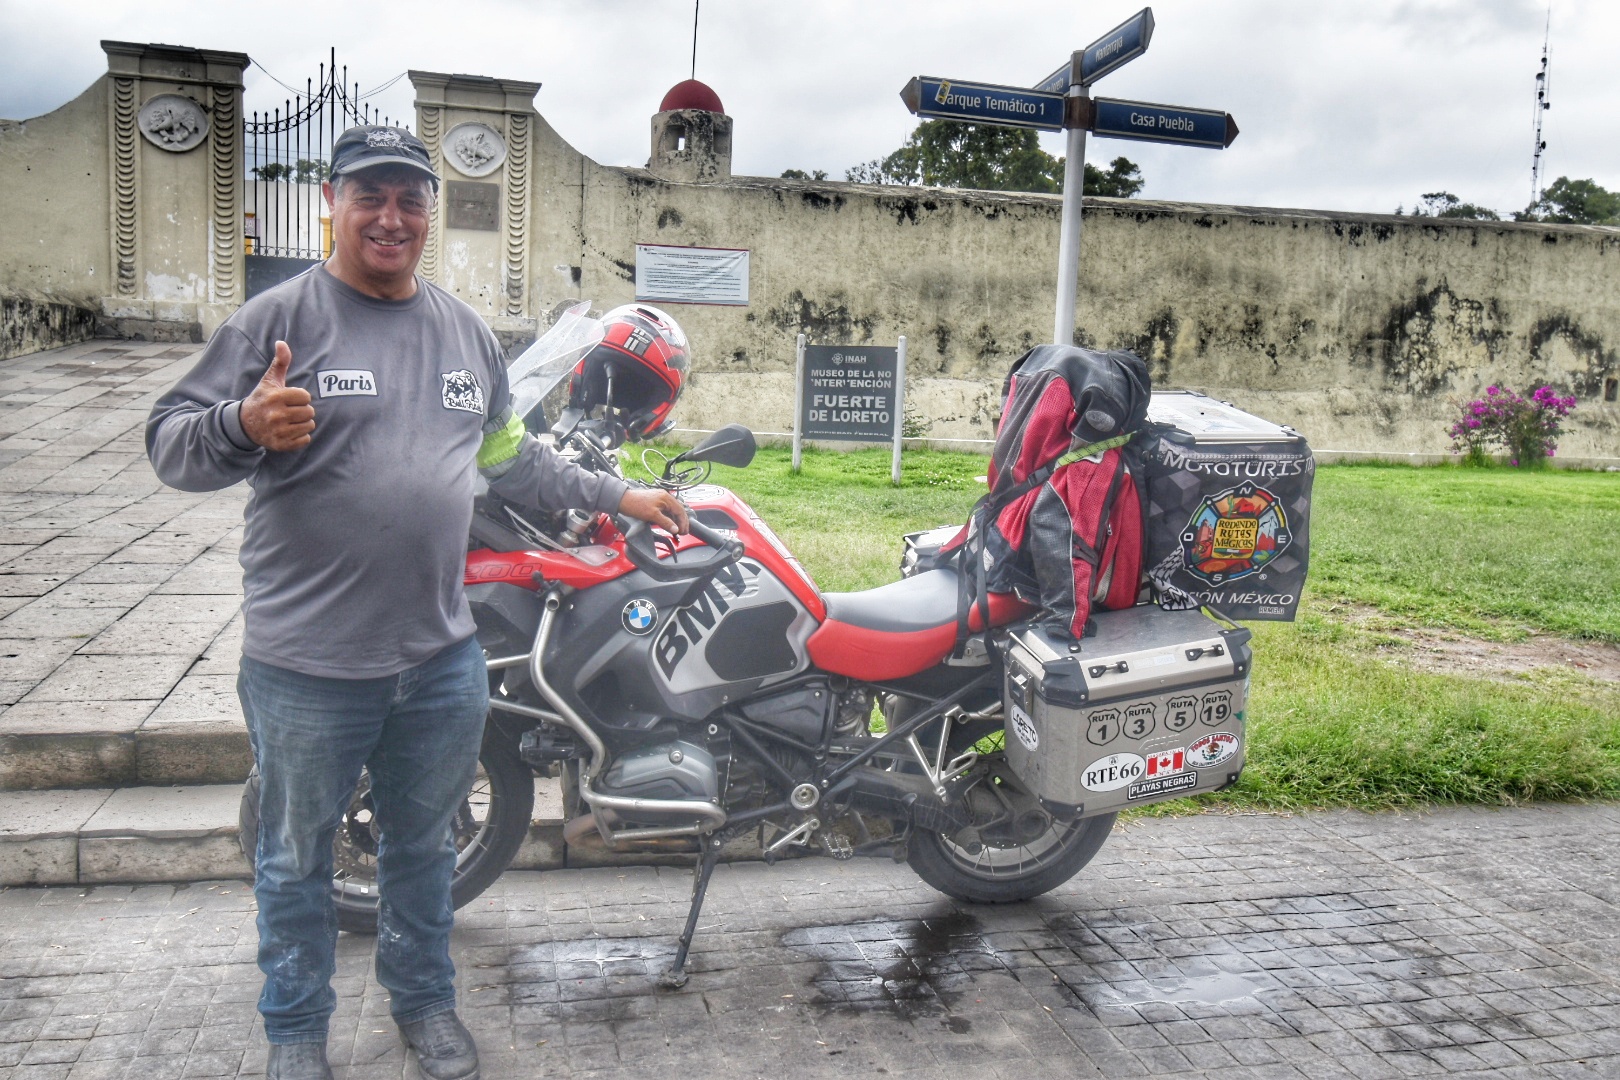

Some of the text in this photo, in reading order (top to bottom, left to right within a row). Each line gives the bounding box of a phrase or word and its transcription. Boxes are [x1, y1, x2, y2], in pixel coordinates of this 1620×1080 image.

[945, 93, 1045, 115] arque Temático 1
[1131, 112, 1194, 131] Casa Puebla
[845, 355, 867, 363] INAH
[811, 369, 845, 377] MUSEO
[862, 370, 875, 378] LA
[323, 374, 372, 392] Paris
[811, 377, 892, 388] NTERENCIÓN
[813, 394, 886, 409] FUERTE
[809, 409, 890, 424] DE LORETO
[1183, 532, 1194, 541] O
[1219, 529, 1252, 538] RUTAS
[1277, 535, 1287, 543] E
[1228, 591, 1294, 605] MÉXICO
[623, 600, 653, 615] BMW
[655, 562, 761, 682] BMW
[1170, 700, 1193, 709] RUTA
[1205, 694, 1228, 704] RUTA
[1091, 713, 1116, 722] RUTA
[1128, 707, 1152, 717] RUTA
[1173, 711, 1187, 727] 5
[1203, 703, 1228, 722] 19
[1012, 709, 1037, 743] LORETO
[1097, 724, 1108, 740] 1
[1132, 718, 1145, 734] 3
[1190, 734, 1235, 752] TODOS SANTOS
[1131, 782, 1162, 795] PLAYAS
[1162, 774, 1194, 789] NEGRAS
